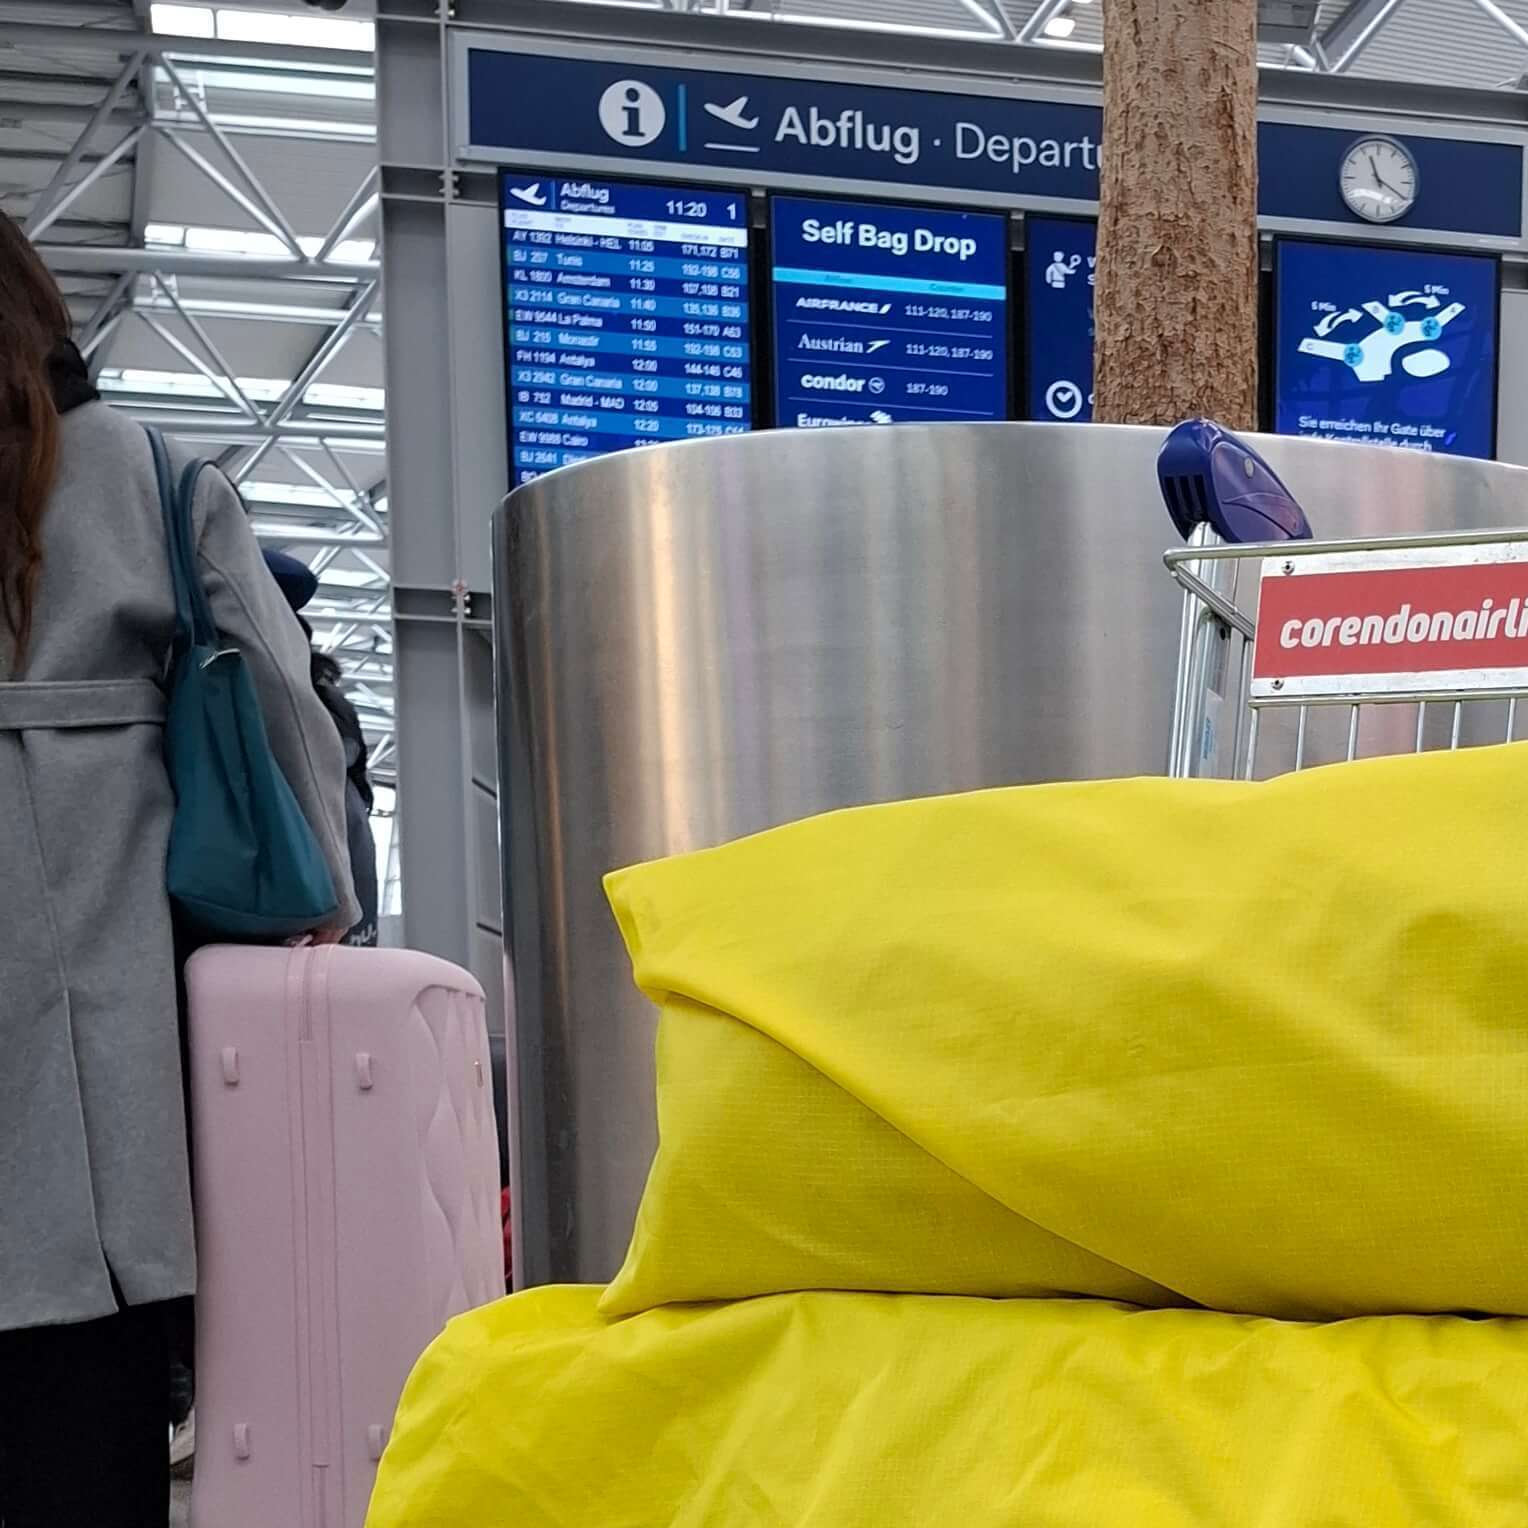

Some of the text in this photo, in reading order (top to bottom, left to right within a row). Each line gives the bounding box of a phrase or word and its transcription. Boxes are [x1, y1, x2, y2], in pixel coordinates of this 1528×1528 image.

[774, 106, 920, 164] Abflug
[560, 182, 610, 203] Abflug
[560, 200, 616, 214] Departures
[666, 200, 737, 220] 11:20 1
[801, 219, 977, 261] Self Bag Drop
[556, 272, 611, 288] Amsterdam
[796, 297, 879, 315] AIRFRANCE
[798, 333, 864, 354] Austrian
[801, 373, 866, 393] condor
[1298, 415, 1318, 429] Sie
[1319, 418, 1372, 434] erreichen
[1391, 422, 1418, 436] Gate
[1419, 424, 1446, 439] über
